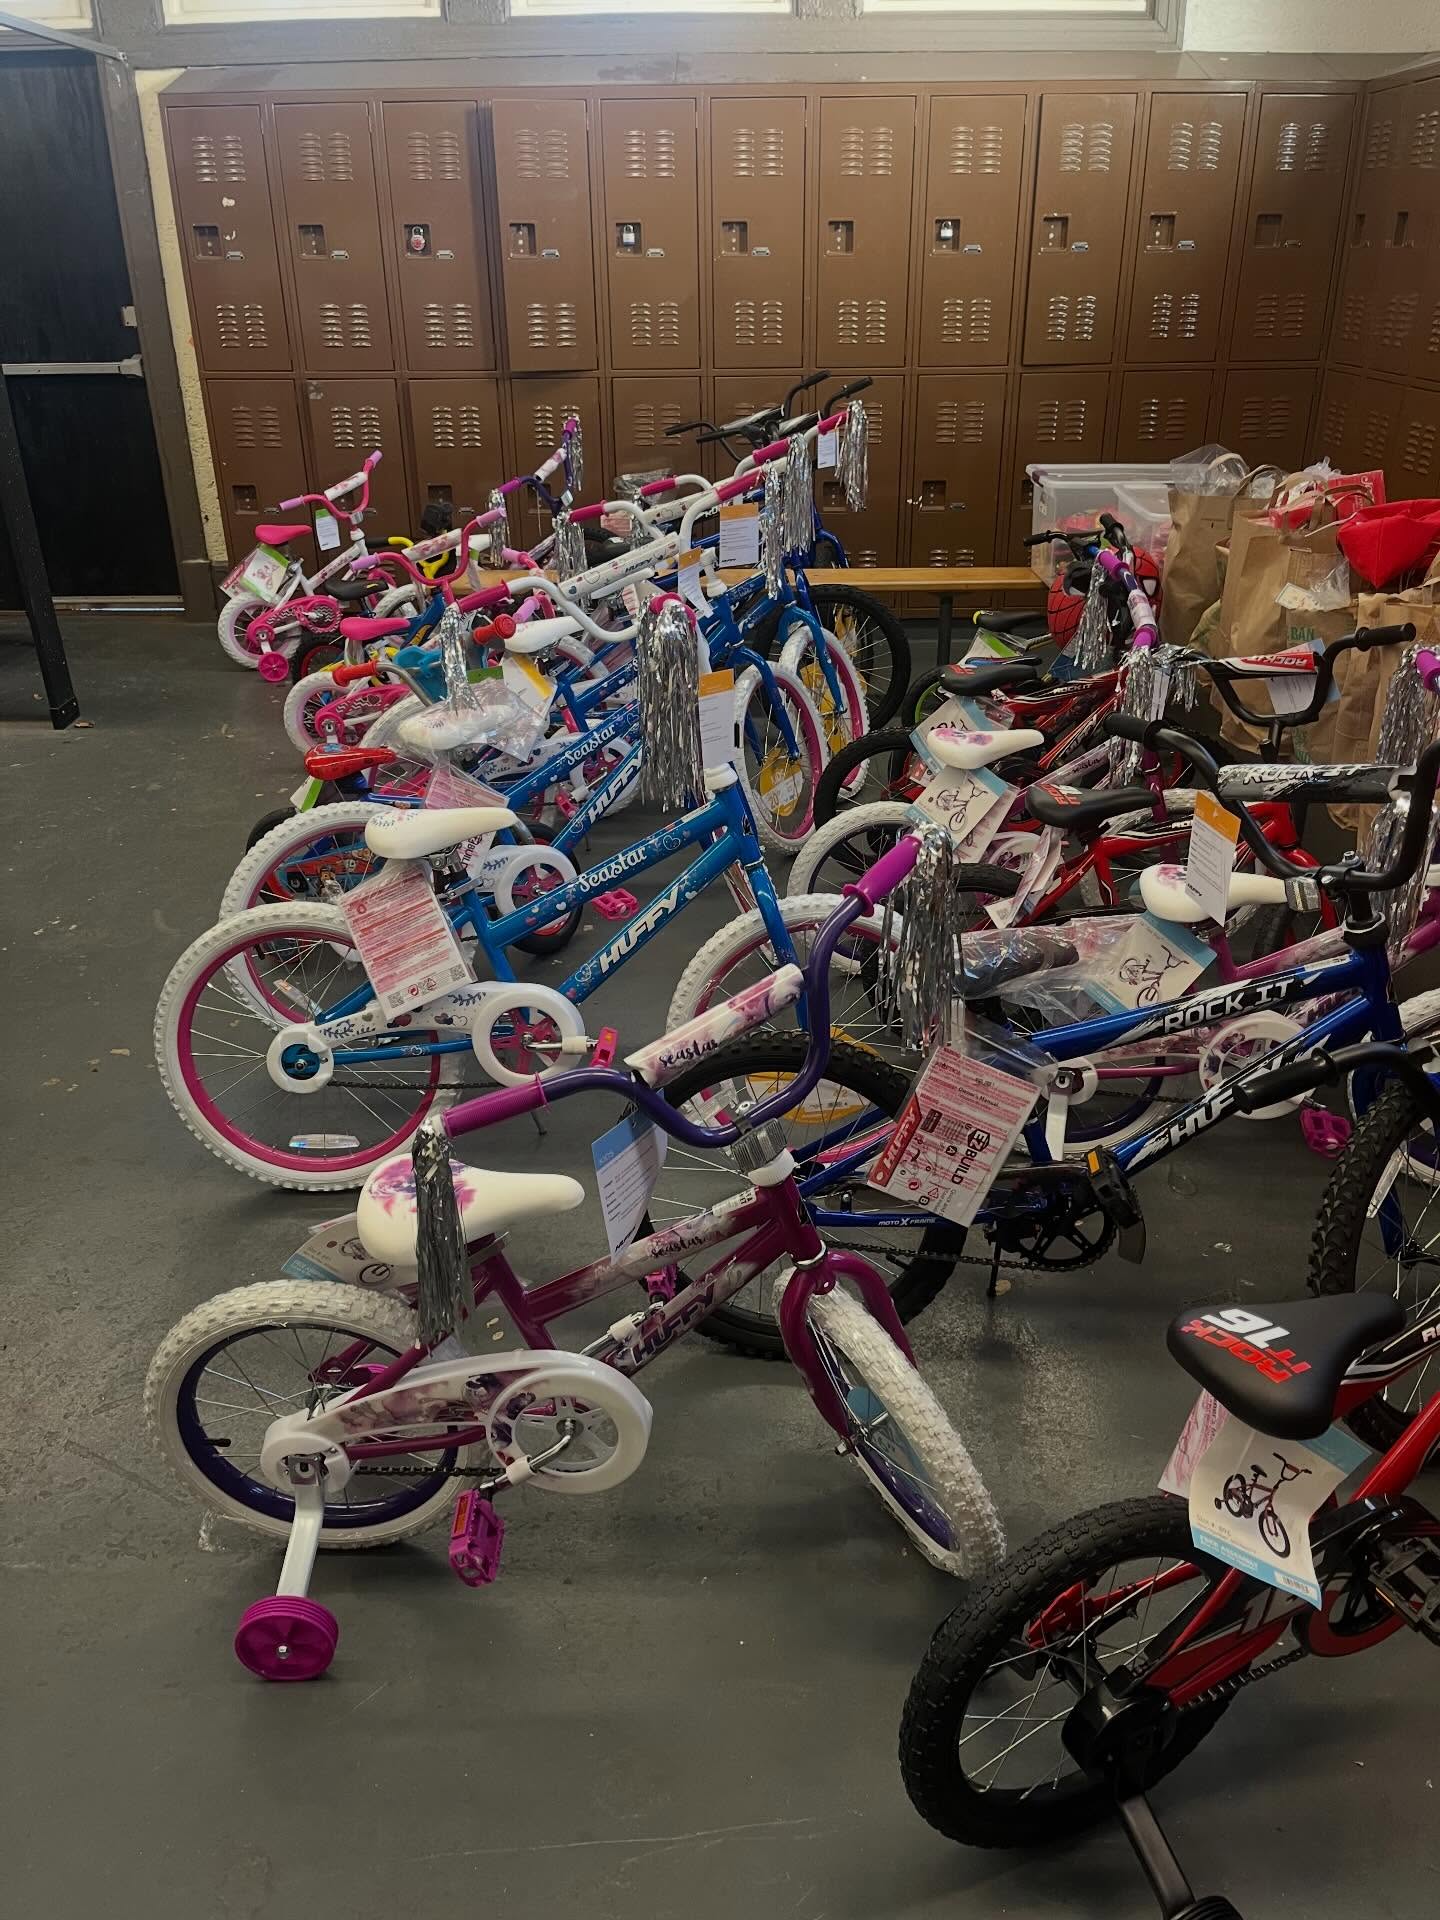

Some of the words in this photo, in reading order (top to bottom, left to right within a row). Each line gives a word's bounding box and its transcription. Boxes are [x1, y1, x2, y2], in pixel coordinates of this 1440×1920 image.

[564, 724, 617, 766] Seastar
[588, 747, 643, 825] HUFFY
[578, 846, 648, 893] Seastar
[599, 886, 679, 974] HUFFY
[1164, 991, 1245, 1034] ROCK
[1256, 977, 1295, 1006] IT
[899, 1217, 910, 1226] X
[630, 1281, 715, 1367] HUFFY
[1181, 1318, 1293, 1385] ROCK
[1200, 1308, 1291, 1350] 16
